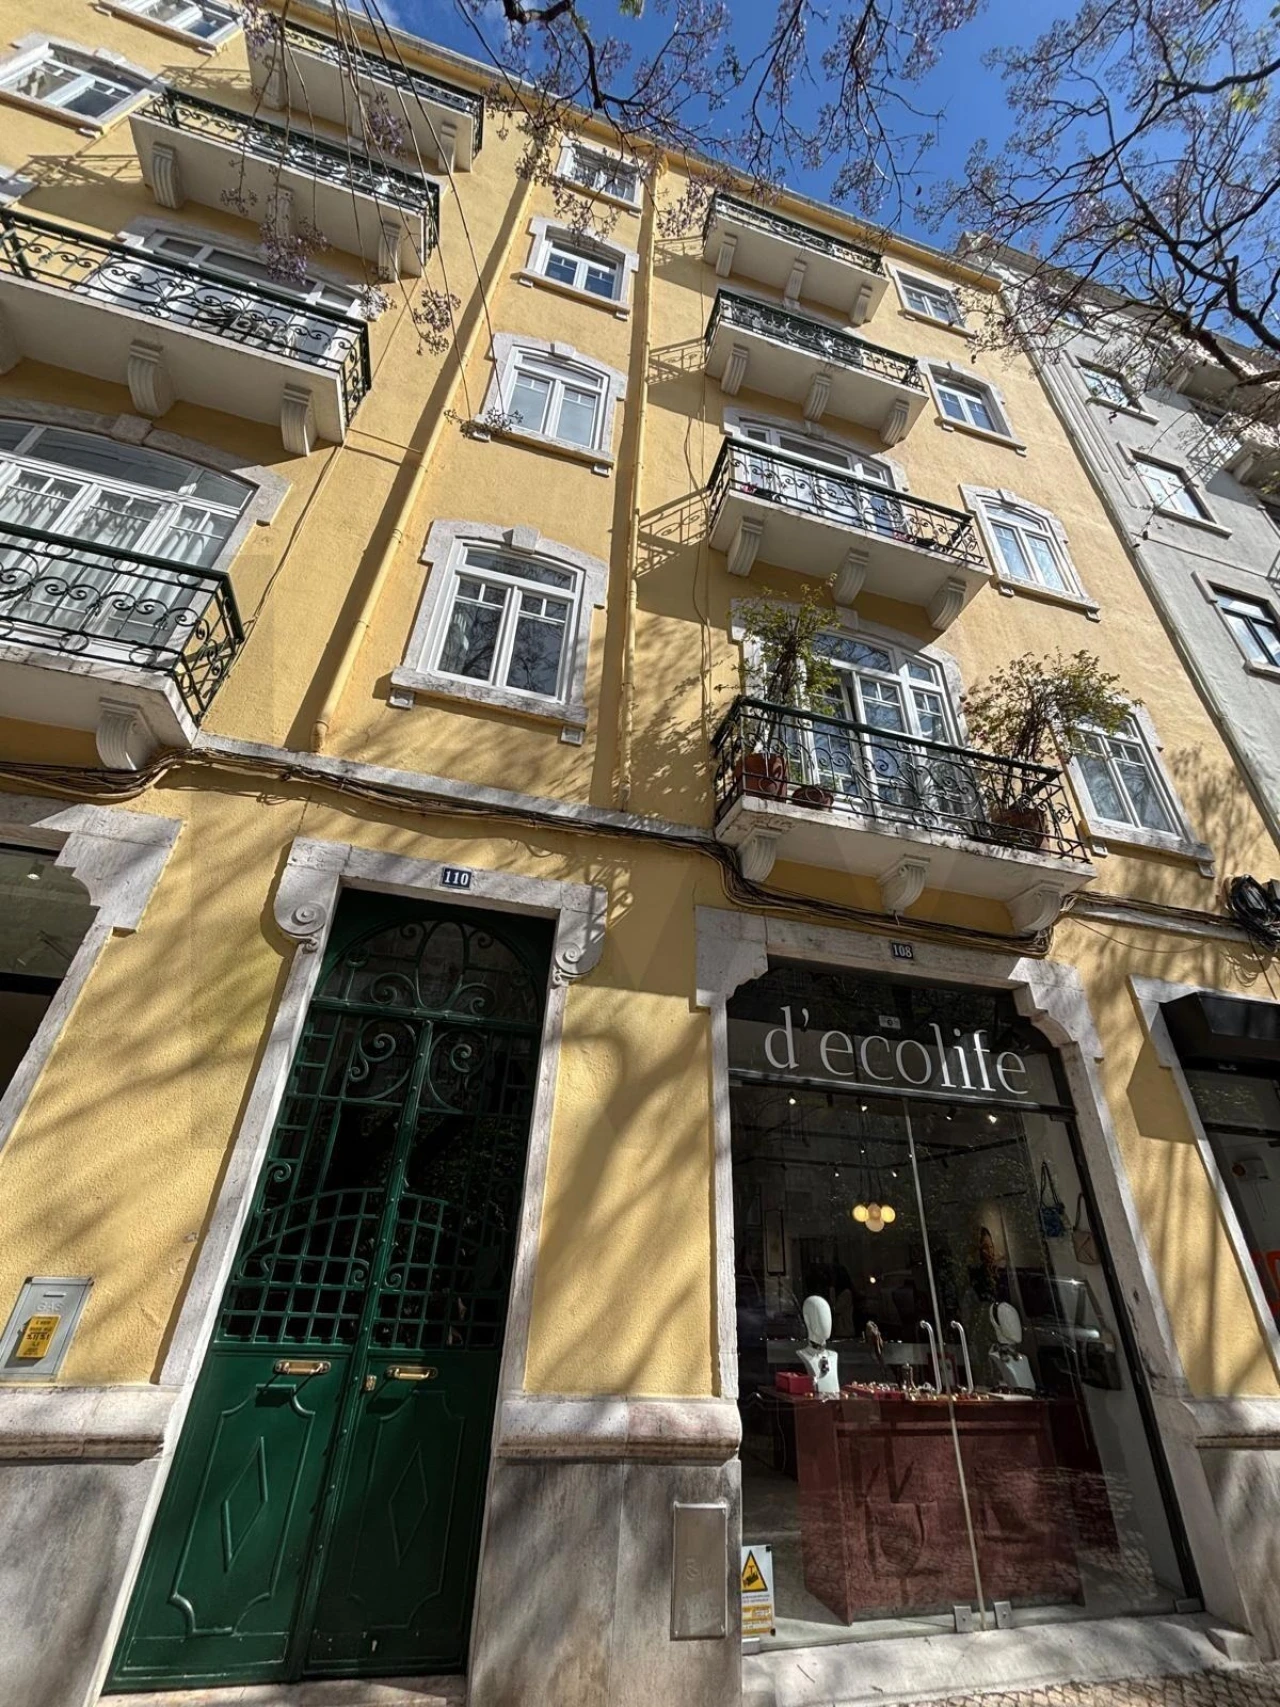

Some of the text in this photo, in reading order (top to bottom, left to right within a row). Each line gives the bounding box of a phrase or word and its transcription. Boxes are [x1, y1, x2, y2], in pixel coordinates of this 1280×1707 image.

[445, 870, 469, 886] 110
[893, 944, 912, 958] 108
[764, 1005, 1029, 1095] d'ecolife
